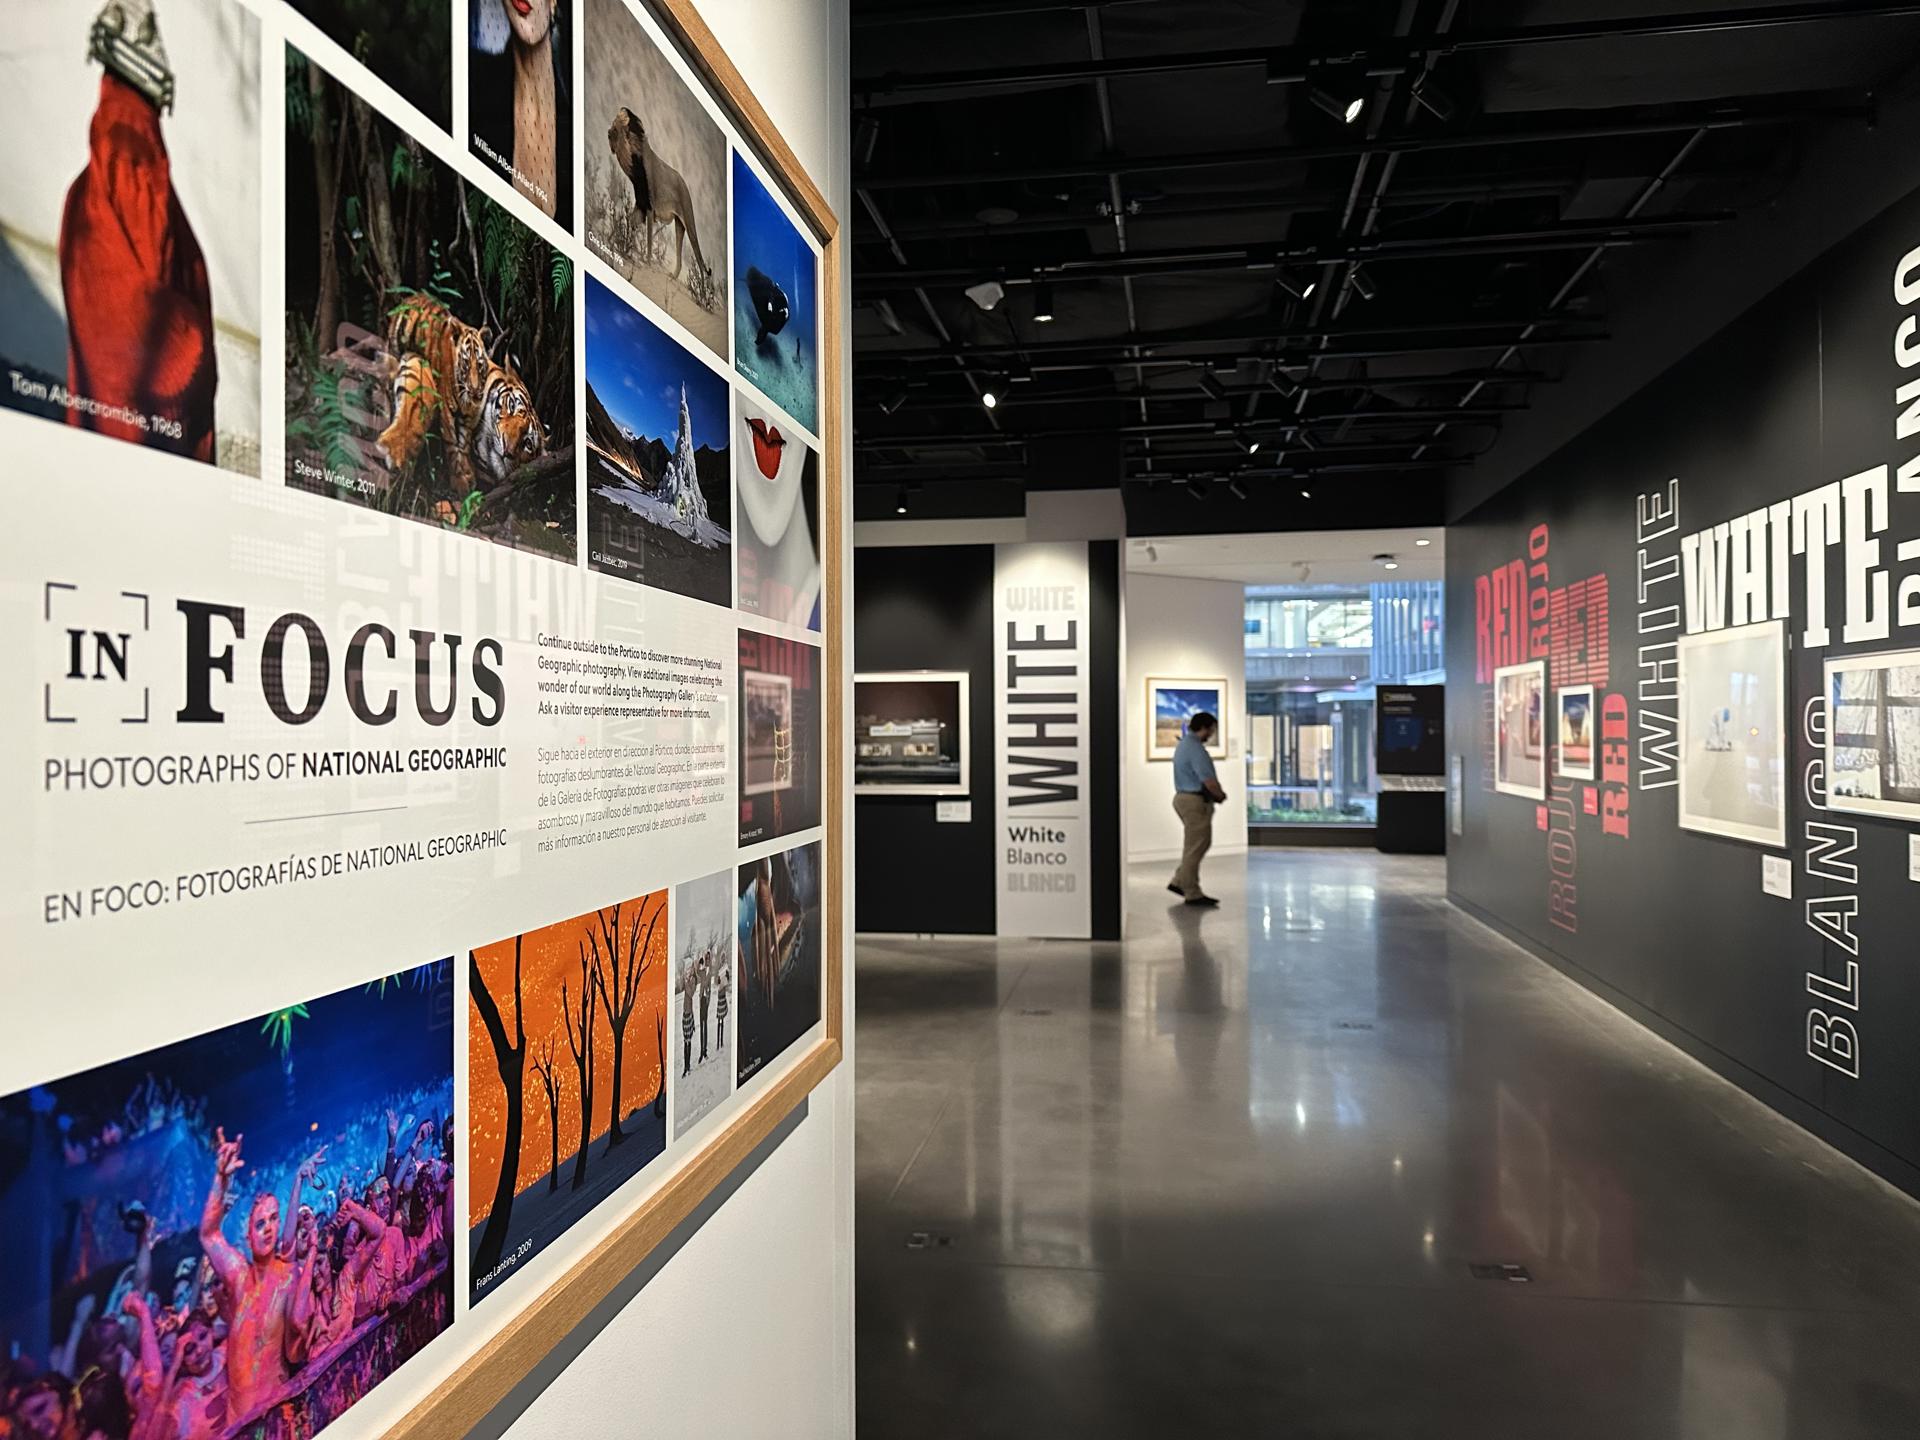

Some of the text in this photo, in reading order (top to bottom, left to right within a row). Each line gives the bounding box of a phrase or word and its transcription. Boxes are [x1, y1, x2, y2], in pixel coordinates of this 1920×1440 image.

[474, 133, 498, 161] William
[8, 370, 183, 440] Tom Abercrombie, 1968
[294, 459, 376, 495] Steve Winter, 2011
[1681, 464, 1889, 649] WHITE
[1006, 584, 1076, 612] WHITE
[1529, 523, 1549, 658] ROJO
[1476, 558, 1530, 684] RED
[1637, 479, 1680, 791] WHITE
[66, 629, 132, 682] IN
[176, 598, 507, 727] FOCUS
[538, 632, 722, 671] Continue outside to the Portico to discover more stunning National
[538, 655, 581, 675] Geographic
[583, 660, 626, 679] photography.
[627, 666, 642, 678] View
[643, 668, 670, 682] additional
[671, 671, 688, 685] images
[689, 674, 714, 688] celebrating
[538, 679, 568, 693] wonder
[569, 680, 578, 694] of
[579, 684, 591, 694] our
[592, 683, 611, 696] world
[613, 684, 630, 700] along
[631, 685, 641, 698] the
[642, 686, 678, 702] Photography
[538, 700, 553, 715] Ask
[554, 704, 558, 715] a
[560, 701, 582, 715] visitor
[584, 704, 619, 718] experience
[620, 705, 661, 719] representative
[670, 709, 682, 718] more
[1007, 620, 1079, 807] WHITE
[45, 747, 507, 792] PHOTOGRAPHS OF NATIONAL GEOGRAPHIC
[538, 747, 559, 765] Sigue
[561, 748, 579, 760] hacia
[580, 746, 586, 760] el
[588, 747, 613, 760] exterior
[614, 748, 622, 758] en
[622, 745, 648, 758] dirección
[649, 744, 654, 757] al
[1603, 694, 1630, 840] RED
[538, 767, 577, 787] fotografías
[578, 767, 624, 781] deslumbrantes
[625, 764, 633, 777] de
[634, 762, 656, 776] National
[538, 792, 549, 807] de
[550, 792, 556, 806] la
[583, 788, 592, 802] de
[593, 784, 627, 802] Fotografías
[648, 784, 656, 794] ver
[538, 813, 578, 830] asombroso
[580, 814, 585, 826] y
[586, 806, 622, 822] maravilloso
[622, 803, 632, 816] del
[633, 801, 653, 814] mundo
[653, 802, 664, 814] que
[538, 837, 553, 853] más
[554, 829, 596, 849] información
[597, 831, 601, 841] a
[603, 827, 626, 840] nuestro
[626, 819, 651, 838] personal
[652, 820, 660, 831] de
[660, 815, 681, 829] atención
[682, 813, 687, 825] al
[1008, 826, 1066, 844] White
[44, 828, 507, 924] EN FOCO: FOTOGRAFÍAS DE NATIONAL GEOGRAPHIC
[1007, 847, 1067, 866] Blanco
[1008, 871, 1076, 894] BLANCO
[476, 1271, 493, 1290] Frans
[517, 1238, 533, 1258] 2009
